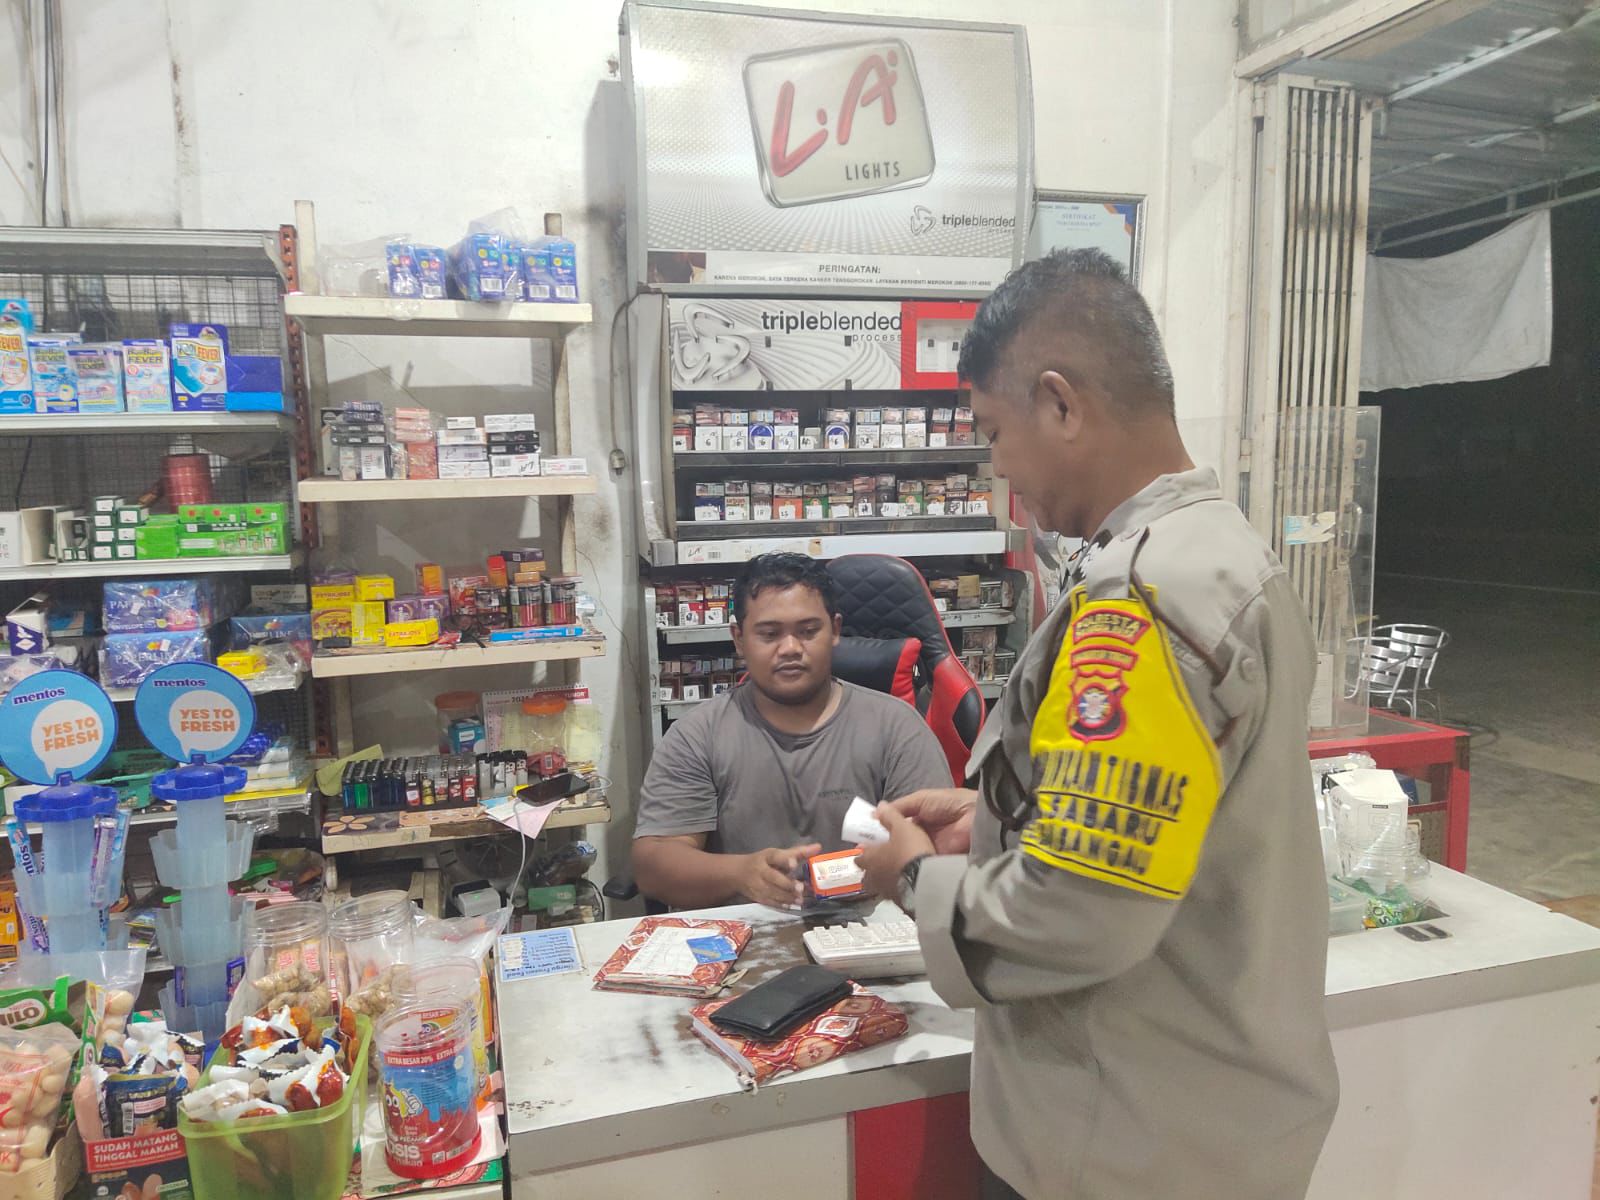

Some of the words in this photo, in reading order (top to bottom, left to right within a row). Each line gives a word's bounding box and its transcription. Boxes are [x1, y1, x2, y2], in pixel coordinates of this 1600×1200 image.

[845, 161, 900, 181] LIGHTS
[943, 214, 1016, 229] tripleblended
[819, 264, 881, 274] PERINGATAN:
[761, 311, 902, 334] tripleblended
[852, 333, 902, 342] process
[128, 356, 163, 364] FEVER
[154, 678, 206, 687] mentos
[13, 688, 65, 705] mentos
[180, 708, 209, 719] YES
[213, 708, 234, 719] TO
[42, 721, 73, 738] YES
[75, 716, 96, 730] TO
[181, 720, 235, 732] FRESH
[43, 729, 99, 752] FRESH
[94, 1141, 131, 1154] SUDAH
[133, 1133, 178, 1149] MATANG
[94, 1151, 139, 1163] TINGGAL
[140, 1142, 178, 1156] MAKAN
